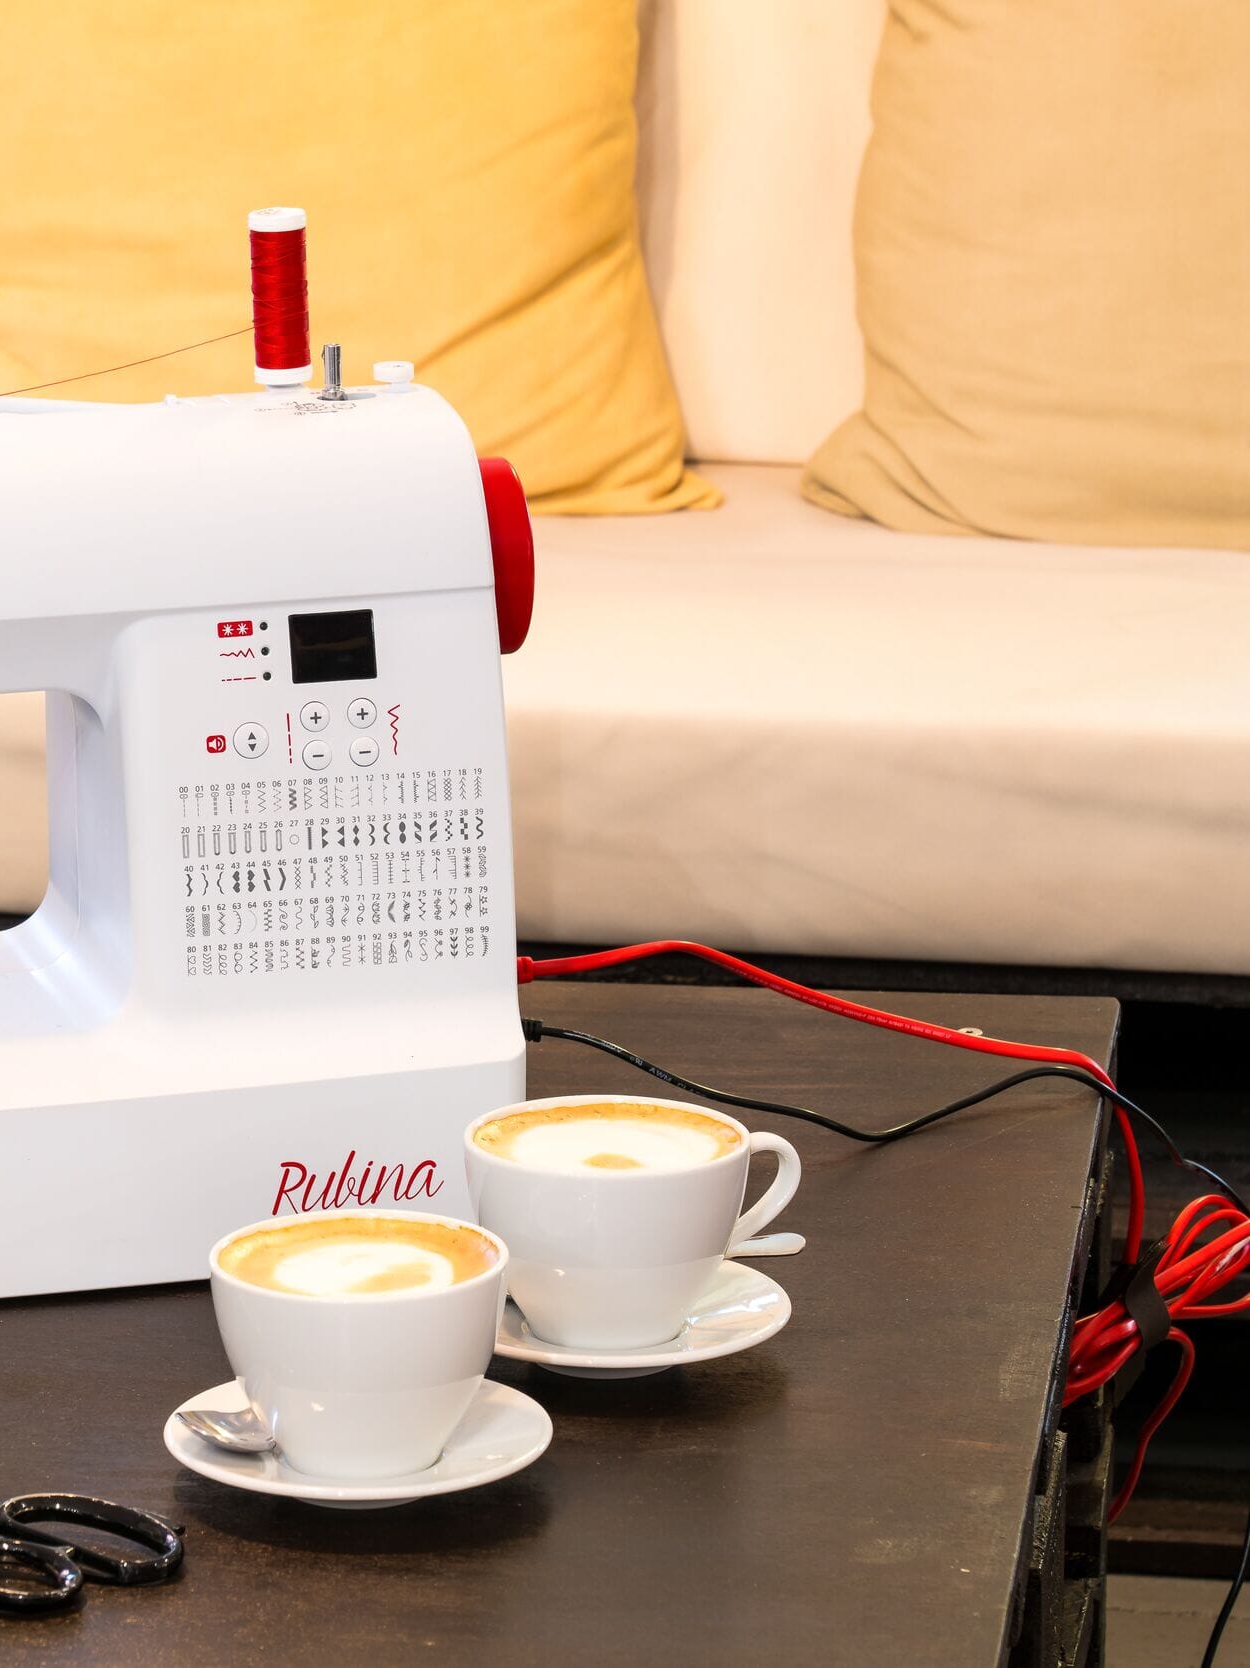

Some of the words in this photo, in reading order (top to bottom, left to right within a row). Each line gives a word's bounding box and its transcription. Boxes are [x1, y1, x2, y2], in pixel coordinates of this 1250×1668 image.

[257, 781, 266, 789] 05
[287, 779, 297, 787] 07
[303, 778, 313, 786] 08
[318, 777, 328, 785] 09
[412, 771, 421, 779] 15
[428, 770, 436, 778] 16
[232, 902, 242, 910] 63
[247, 901, 257, 909] 64
[263, 900, 272, 908] 65
[278, 899, 288, 907] 66
[294, 898, 303, 906] 67
[309, 897, 319, 905] 68
[325, 896, 334, 904] 69
[264, 940, 274, 948] 85
[280, 939, 289, 947] 86
[295, 938, 304, 946] 87
[311, 937, 320, 945] 88
[341, 935, 351, 943] 90
[272, 1150, 444, 1216] Rubina
